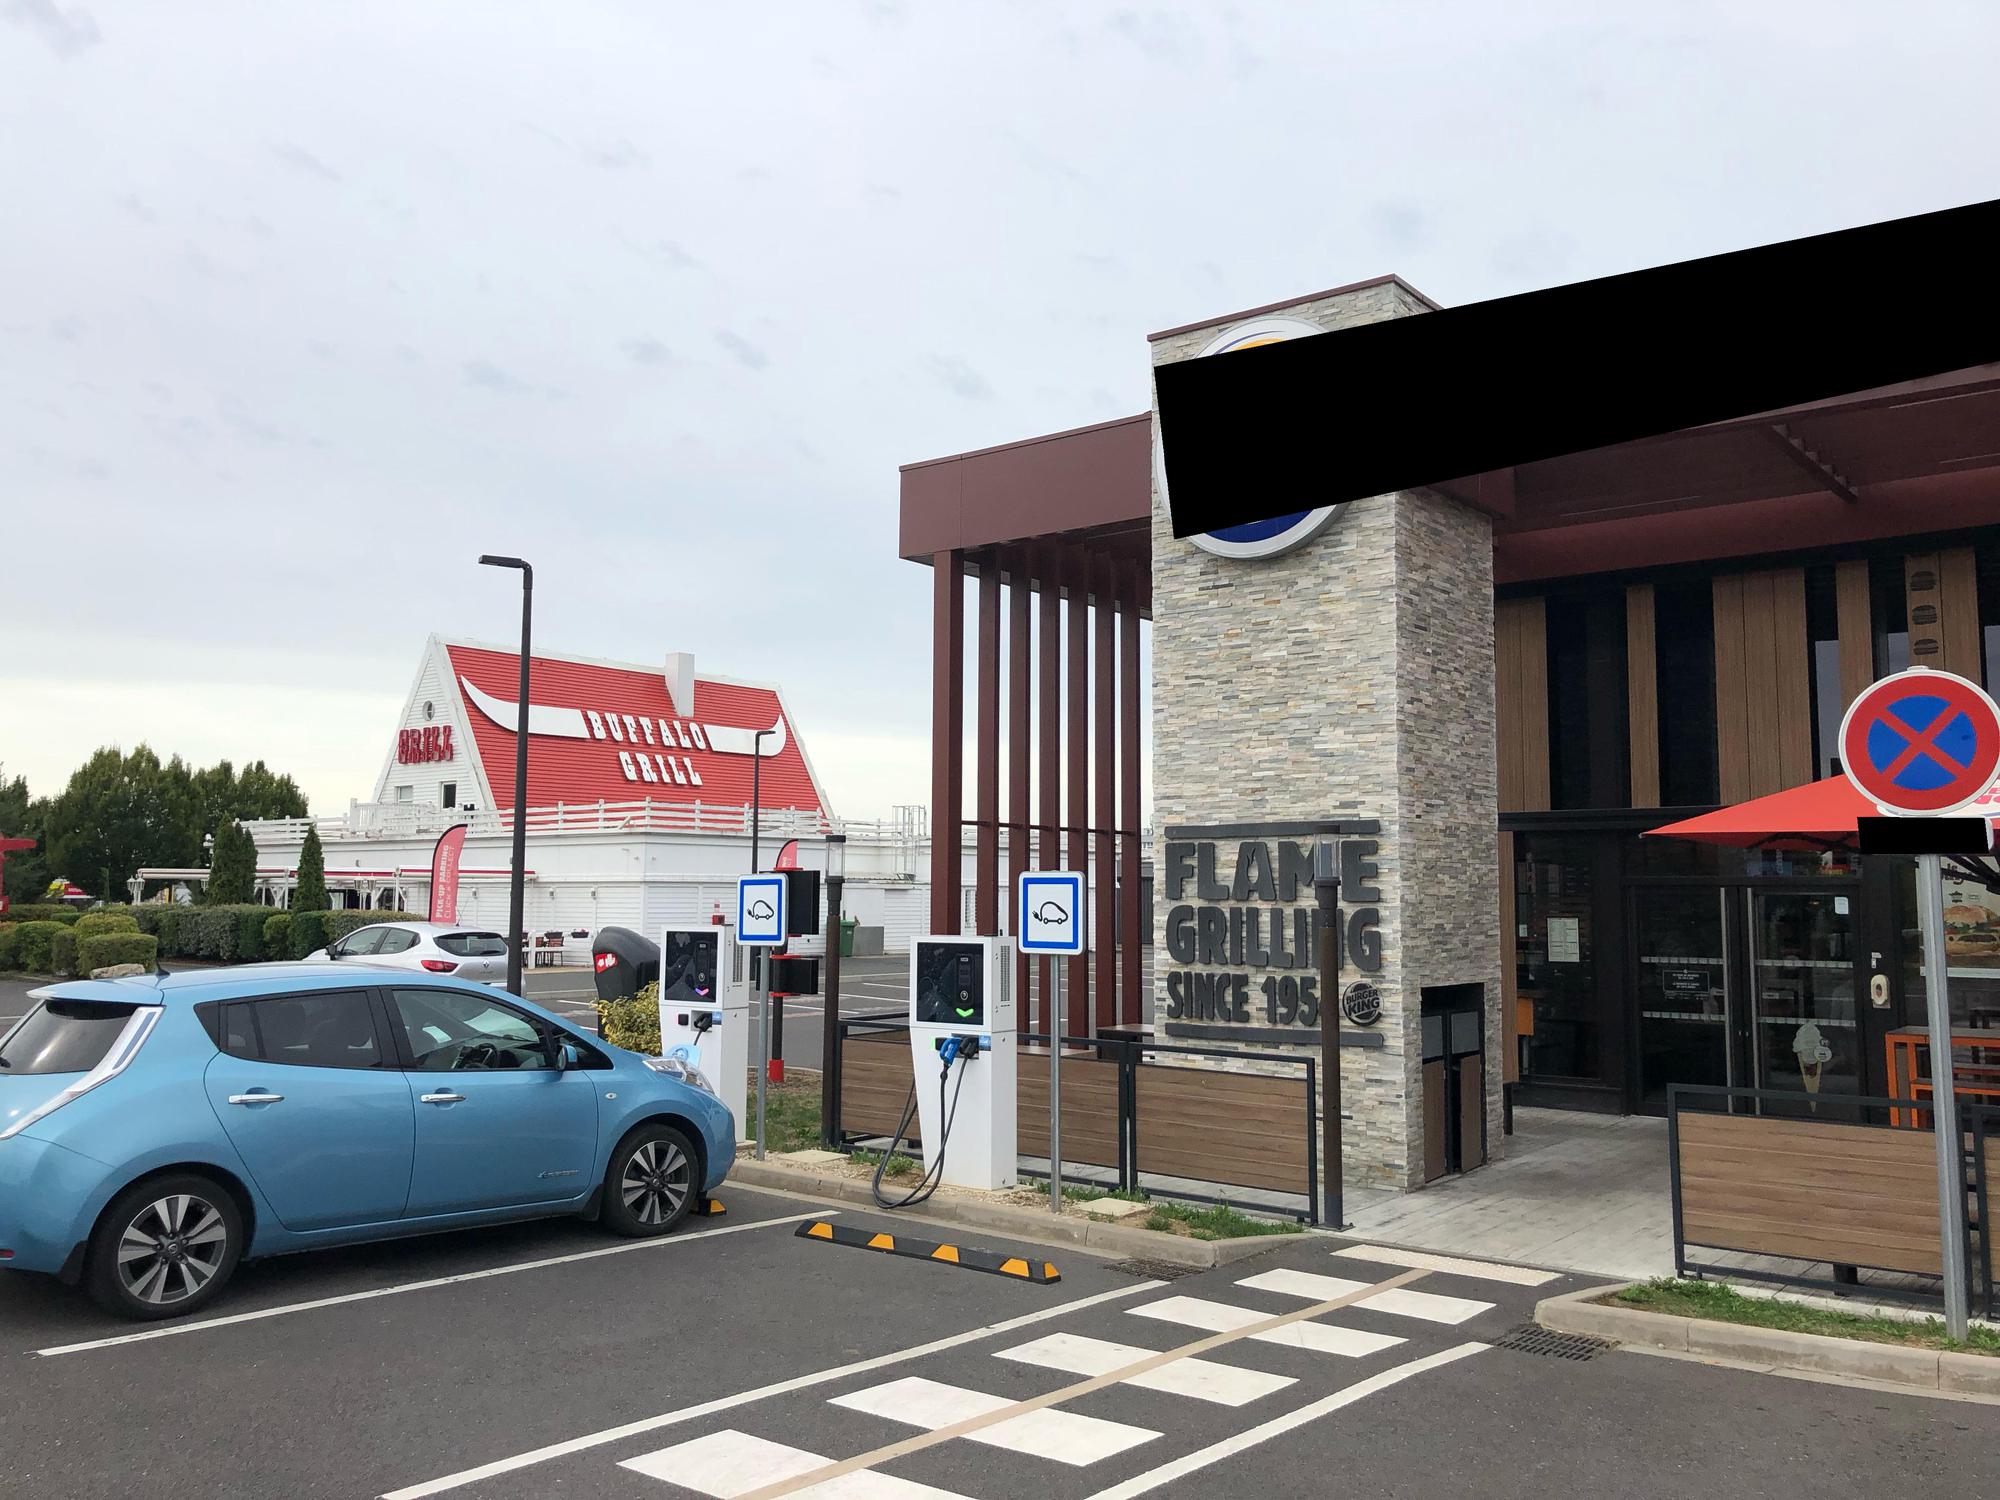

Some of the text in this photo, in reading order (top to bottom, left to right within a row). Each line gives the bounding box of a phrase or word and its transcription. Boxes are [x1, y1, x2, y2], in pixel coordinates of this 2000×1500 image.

[398, 725, 454, 764] GRILL
[586, 709, 707, 750] BUFFALO
[619, 751, 703, 786] GRILL
[1165, 840, 1380, 901] FLAME
[436, 884, 445, 918] PICK-UP
[1167, 971, 1321, 1026] SINCE 195
[1346, 989, 1378, 1005] BURGER
[1347, 997, 1380, 1017] KING
